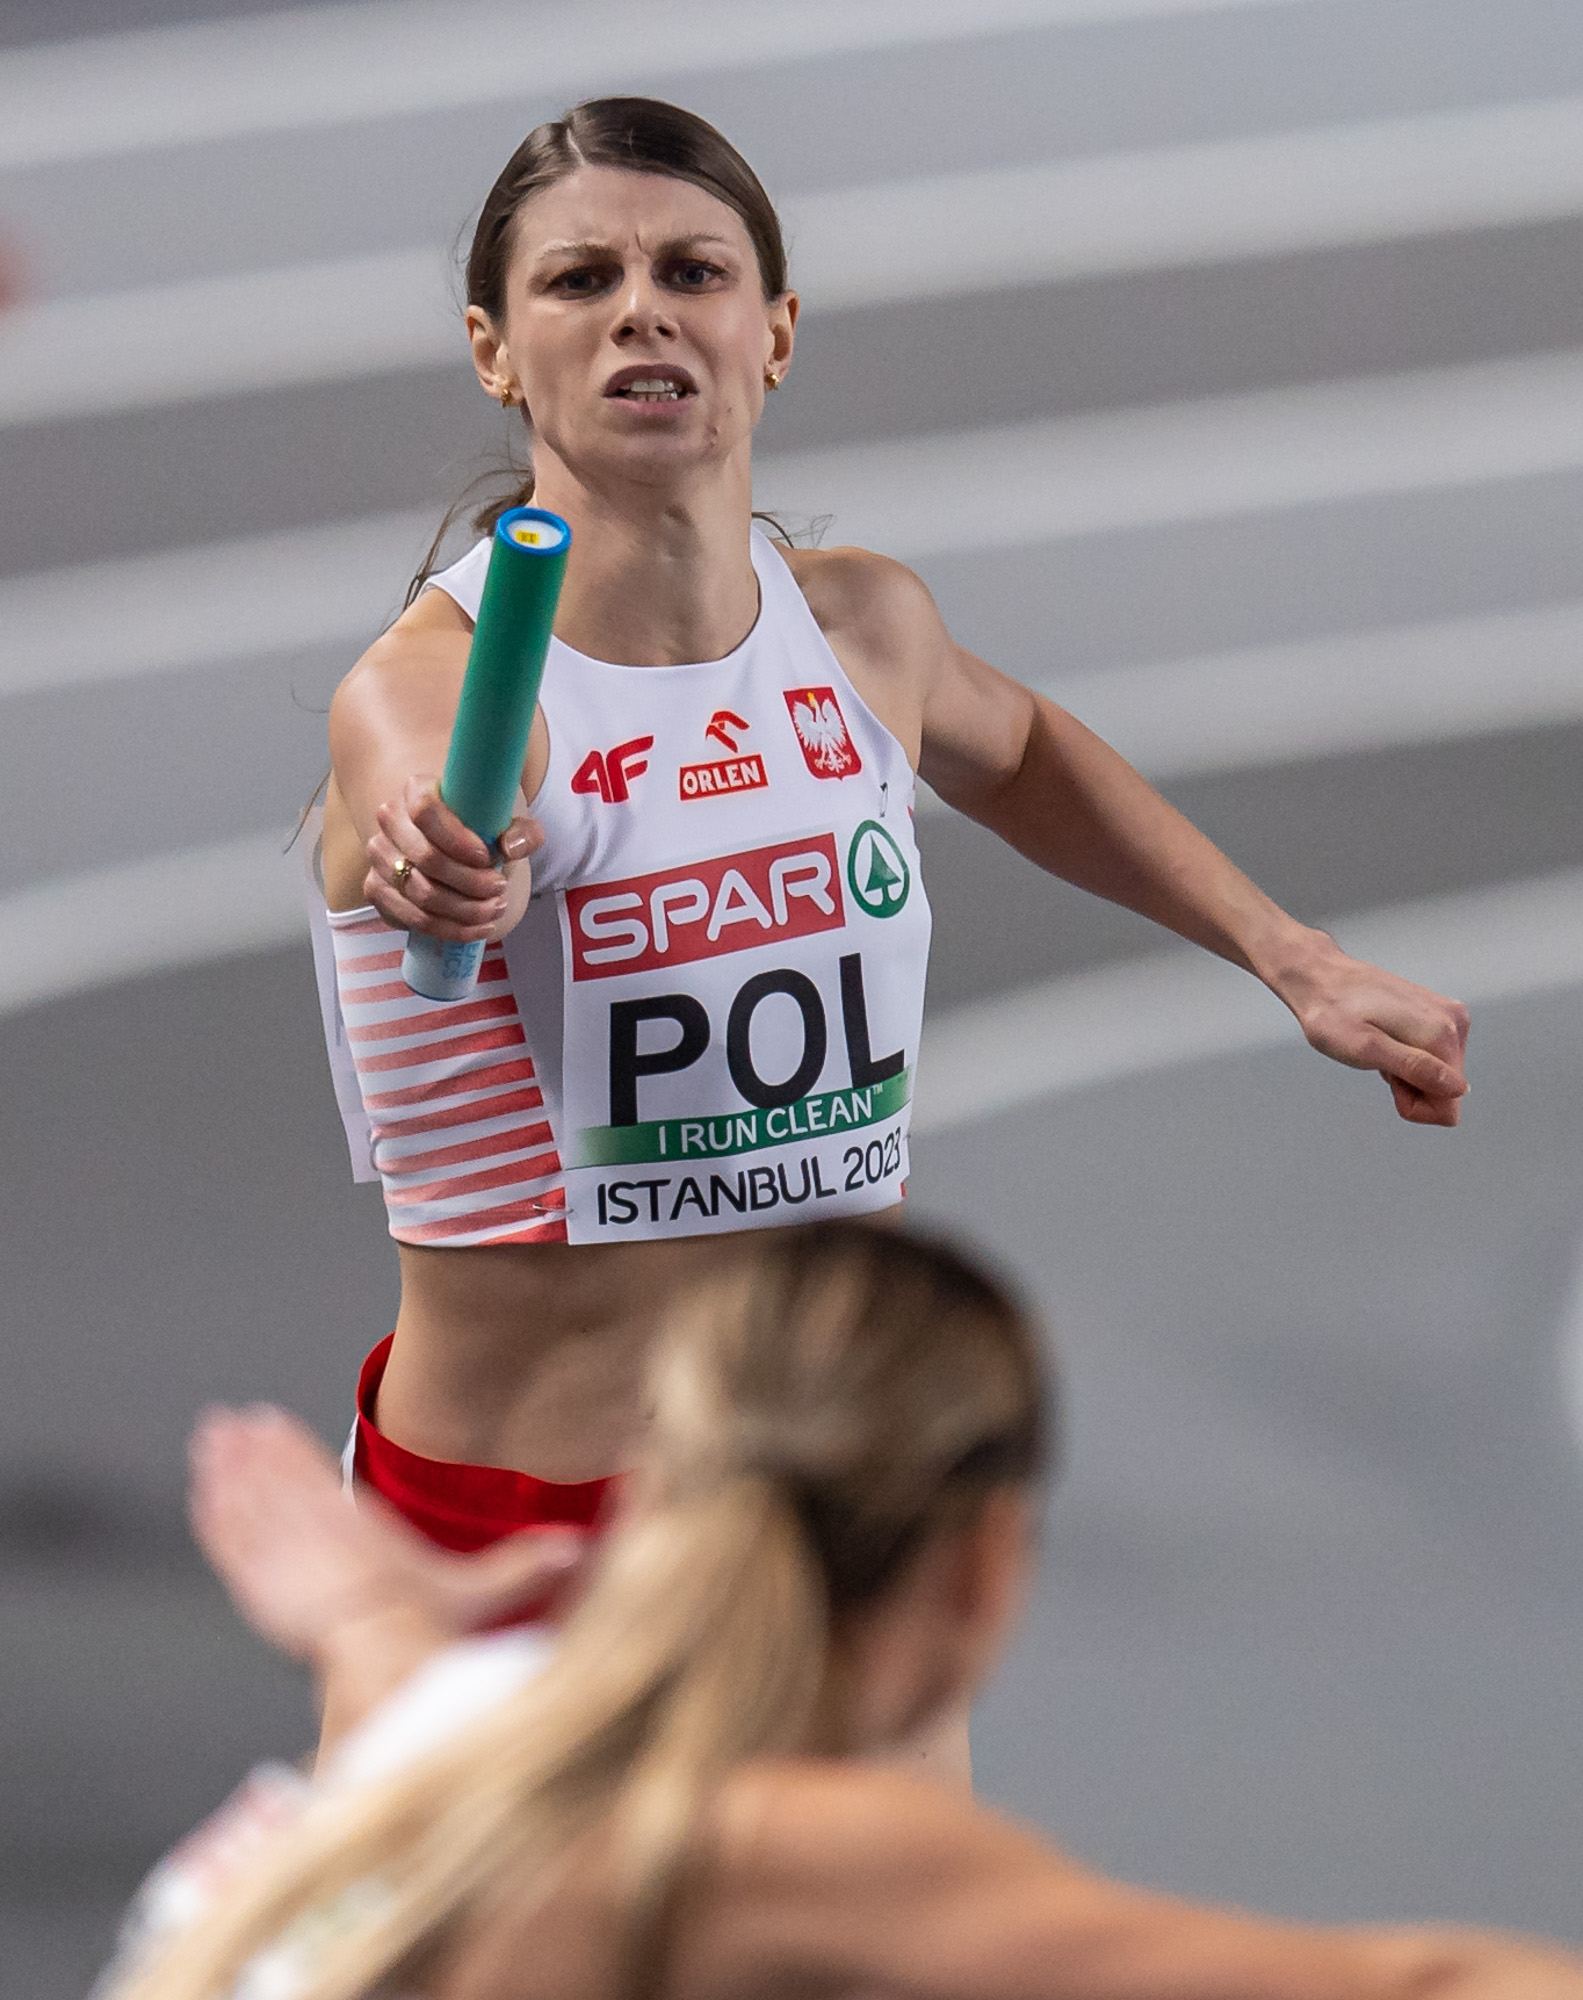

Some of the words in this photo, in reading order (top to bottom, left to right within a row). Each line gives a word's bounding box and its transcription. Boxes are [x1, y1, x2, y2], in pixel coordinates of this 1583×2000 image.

[570, 735, 655, 804] 4F
[682, 760, 761, 796] ORLEN
[579, 850, 836, 965] SPAR
[609, 952, 905, 1128] POL
[597, 1156, 837, 1226] ISTANBUL
[843, 1126, 902, 1193] 2023
[658, 1124, 667, 1155] I
[681, 1114, 758, 1153] RUN
